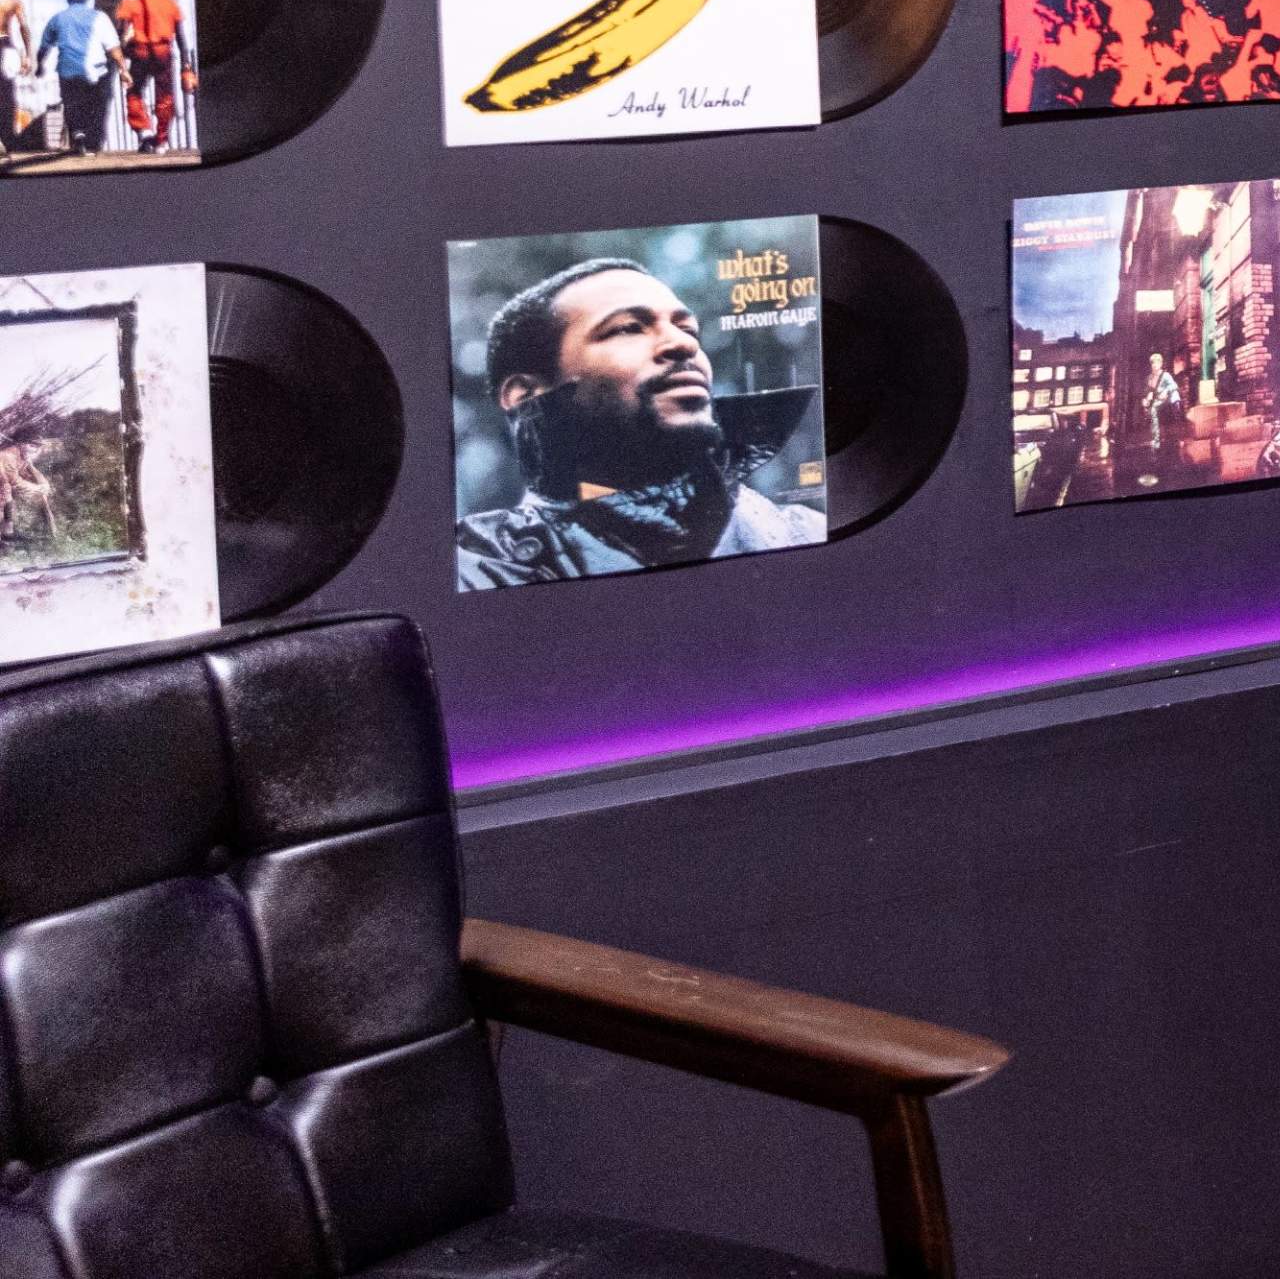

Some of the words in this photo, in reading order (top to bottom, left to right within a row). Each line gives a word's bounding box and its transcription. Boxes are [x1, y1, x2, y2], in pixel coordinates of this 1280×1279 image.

[608, 91, 666, 118] Andy
[679, 85, 751, 109] Warhol
[718, 250, 788, 280] what's
[732, 278, 789, 313] going
[791, 276, 817, 297] on
